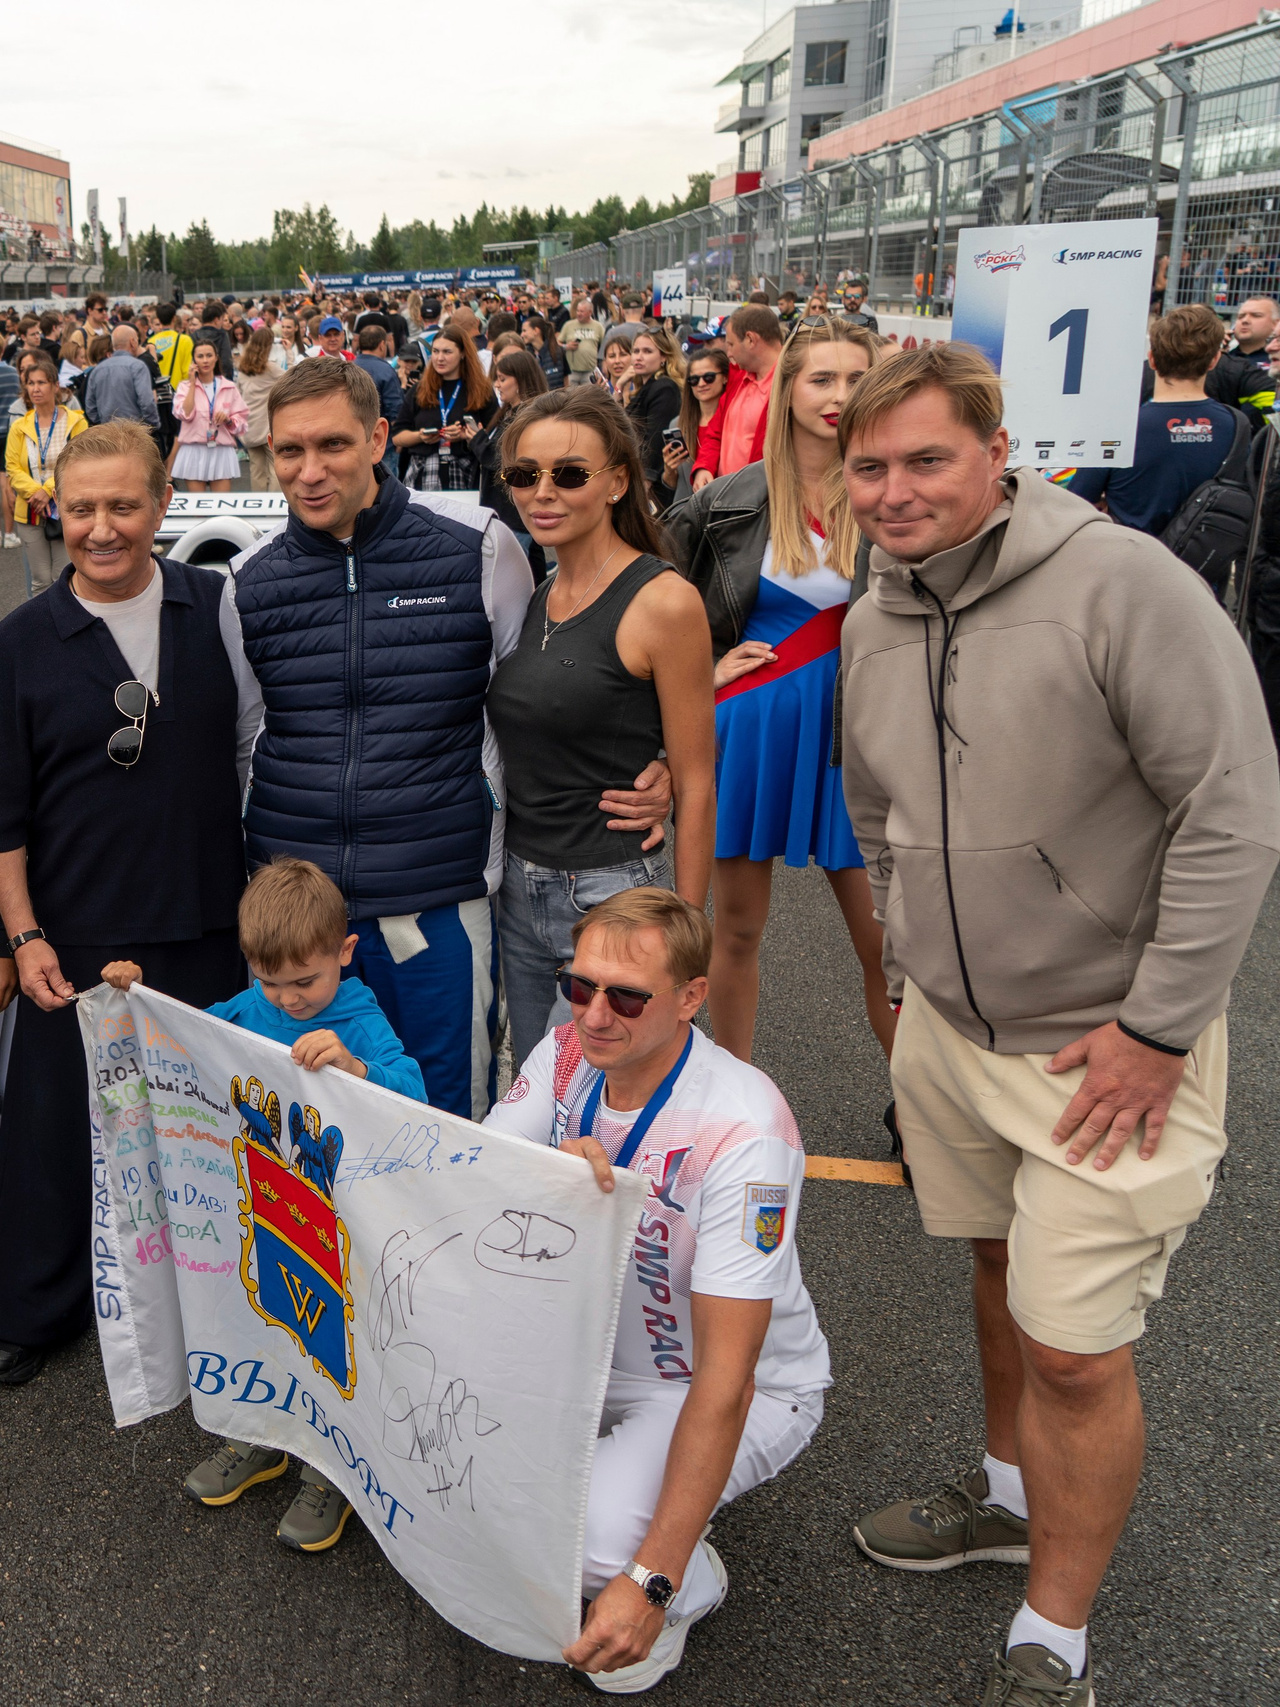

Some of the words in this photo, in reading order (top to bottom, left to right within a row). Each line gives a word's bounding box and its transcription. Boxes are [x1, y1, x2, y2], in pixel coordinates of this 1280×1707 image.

[1069, 252, 1096, 261] SMP
[1097, 249, 1143, 260] RACING
[559, 286, 570, 295] 51
[662, 284, 683, 302] 44
[1049, 309, 1089, 394] 1
[1171, 434, 1213, 443] LEGENDS
[417, 596, 447, 605] RACING
[634, 1210, 672, 1305] SMP
[94, 1236, 122, 1322] SMP
